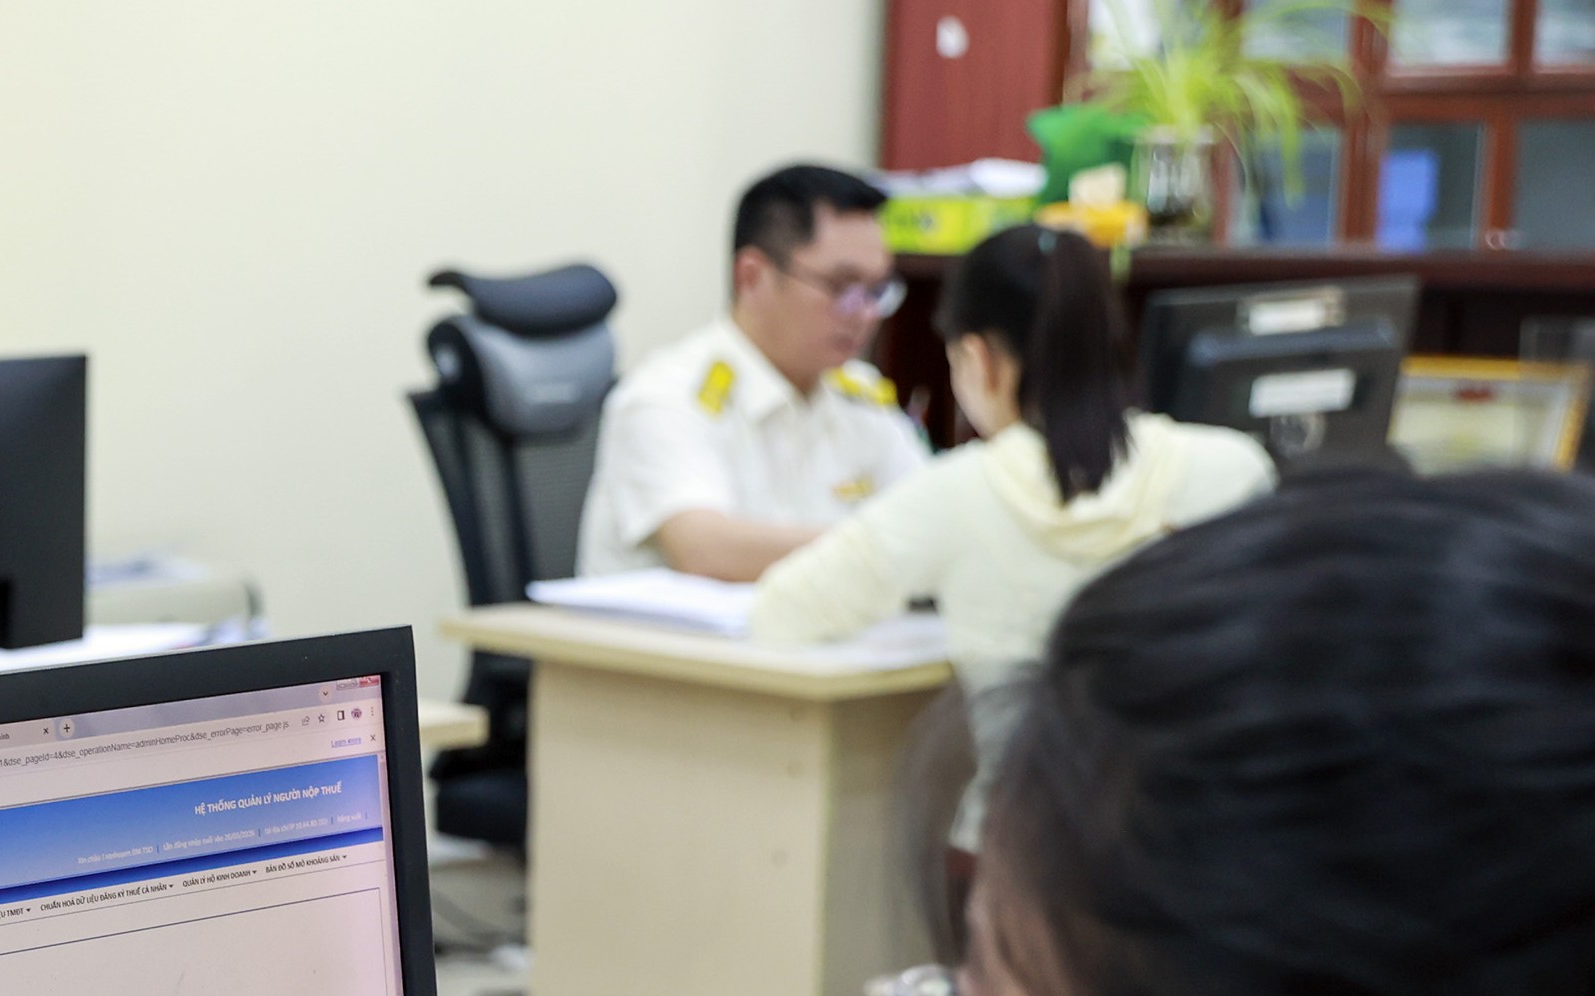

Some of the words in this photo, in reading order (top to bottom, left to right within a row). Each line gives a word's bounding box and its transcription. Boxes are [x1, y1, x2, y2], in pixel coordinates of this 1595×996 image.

[193, 802, 206, 818] HỆ
[207, 797, 237, 813] THỐNG
[237, 793, 262, 809] QUẢN
[262, 792, 272, 805] LÝ
[272, 787, 301, 803] NGƯỜI
[300, 784, 320, 801] NỘP
[319, 779, 342, 796] THUẾ
[182, 876, 199, 887] QUẢN
[199, 875, 206, 884] LÝ
[205, 873, 215, 885] HỘ
[216, 872, 230, 882] KINH
[230, 869, 251, 879] DOANH
